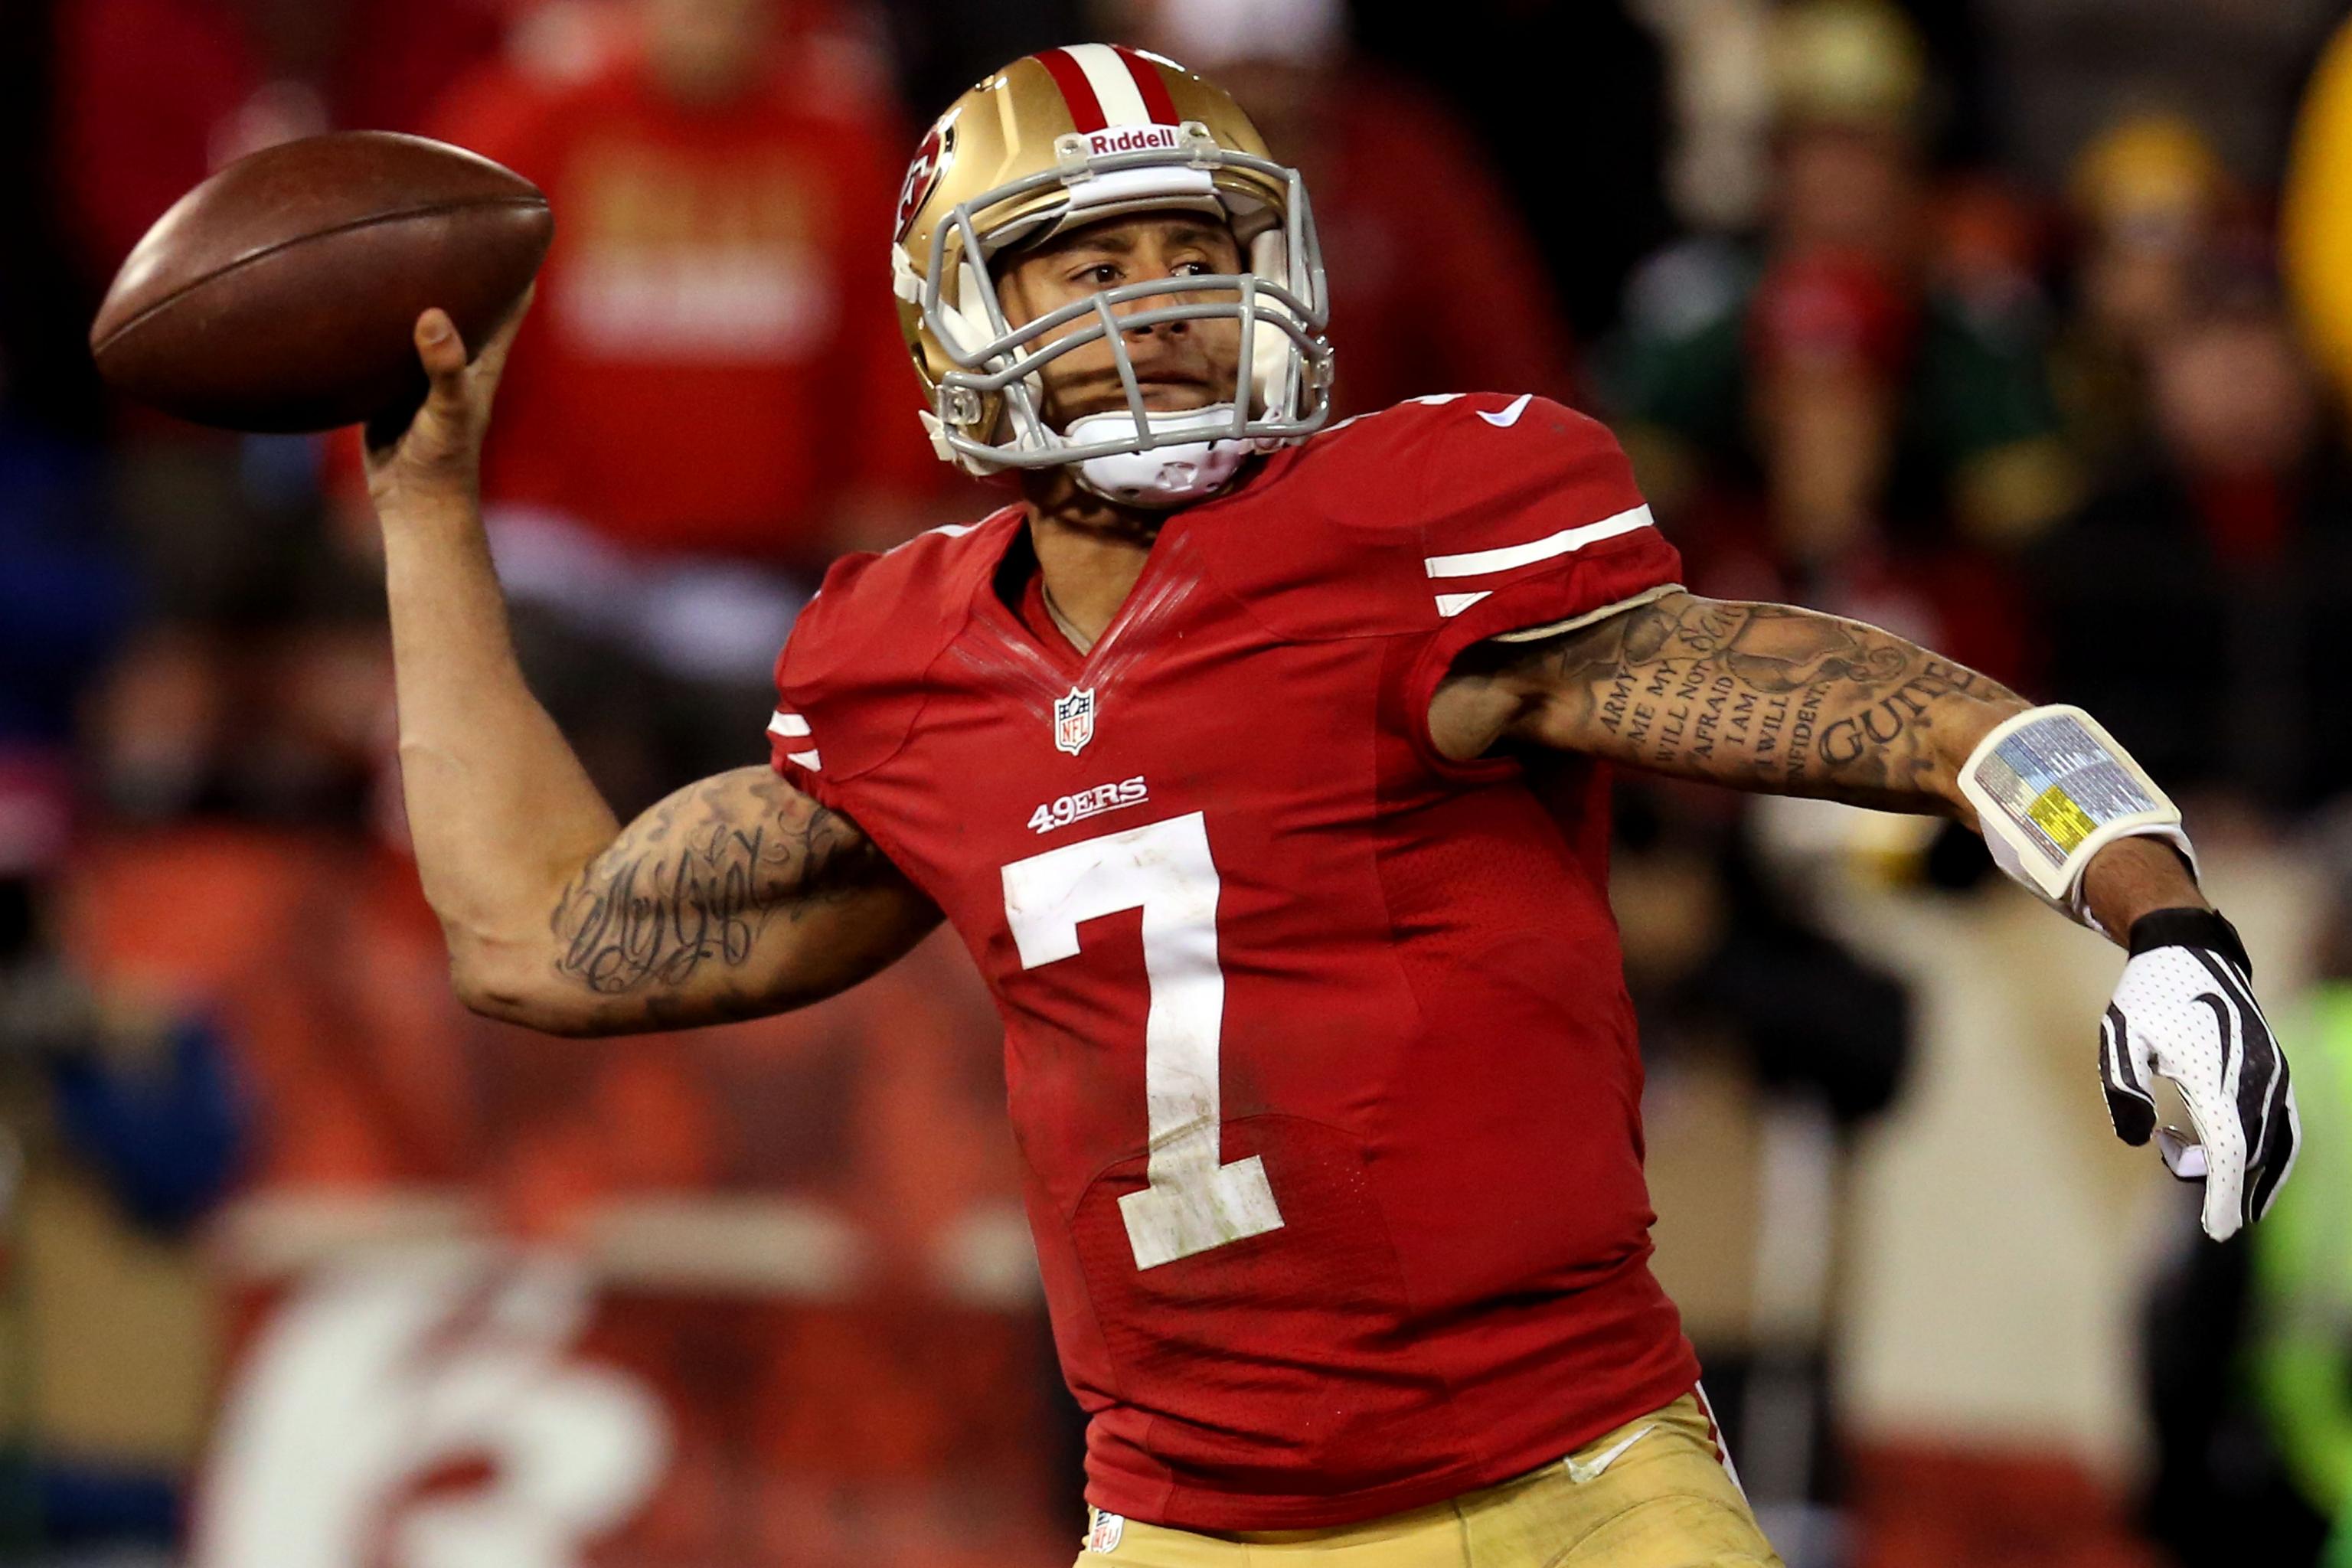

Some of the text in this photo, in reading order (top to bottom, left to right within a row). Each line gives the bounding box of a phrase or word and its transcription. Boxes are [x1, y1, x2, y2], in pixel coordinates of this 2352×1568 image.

[1090, 129, 1174, 154] Riddell
[1061, 716, 1089, 743] NFL
[1600, 665, 1638, 734] ARMY
[1628, 660, 1677, 747] ME MY
[1656, 705, 1690, 762] WILL
[1676, 659, 1712, 700] NOT
[1694, 676, 1735, 760] AFRAID
[1731, 692, 1759, 733] AM
[1756, 695, 1790, 753] WILL
[1027, 775, 1148, 834] 49ERS
[1001, 810, 1285, 1271] 7
